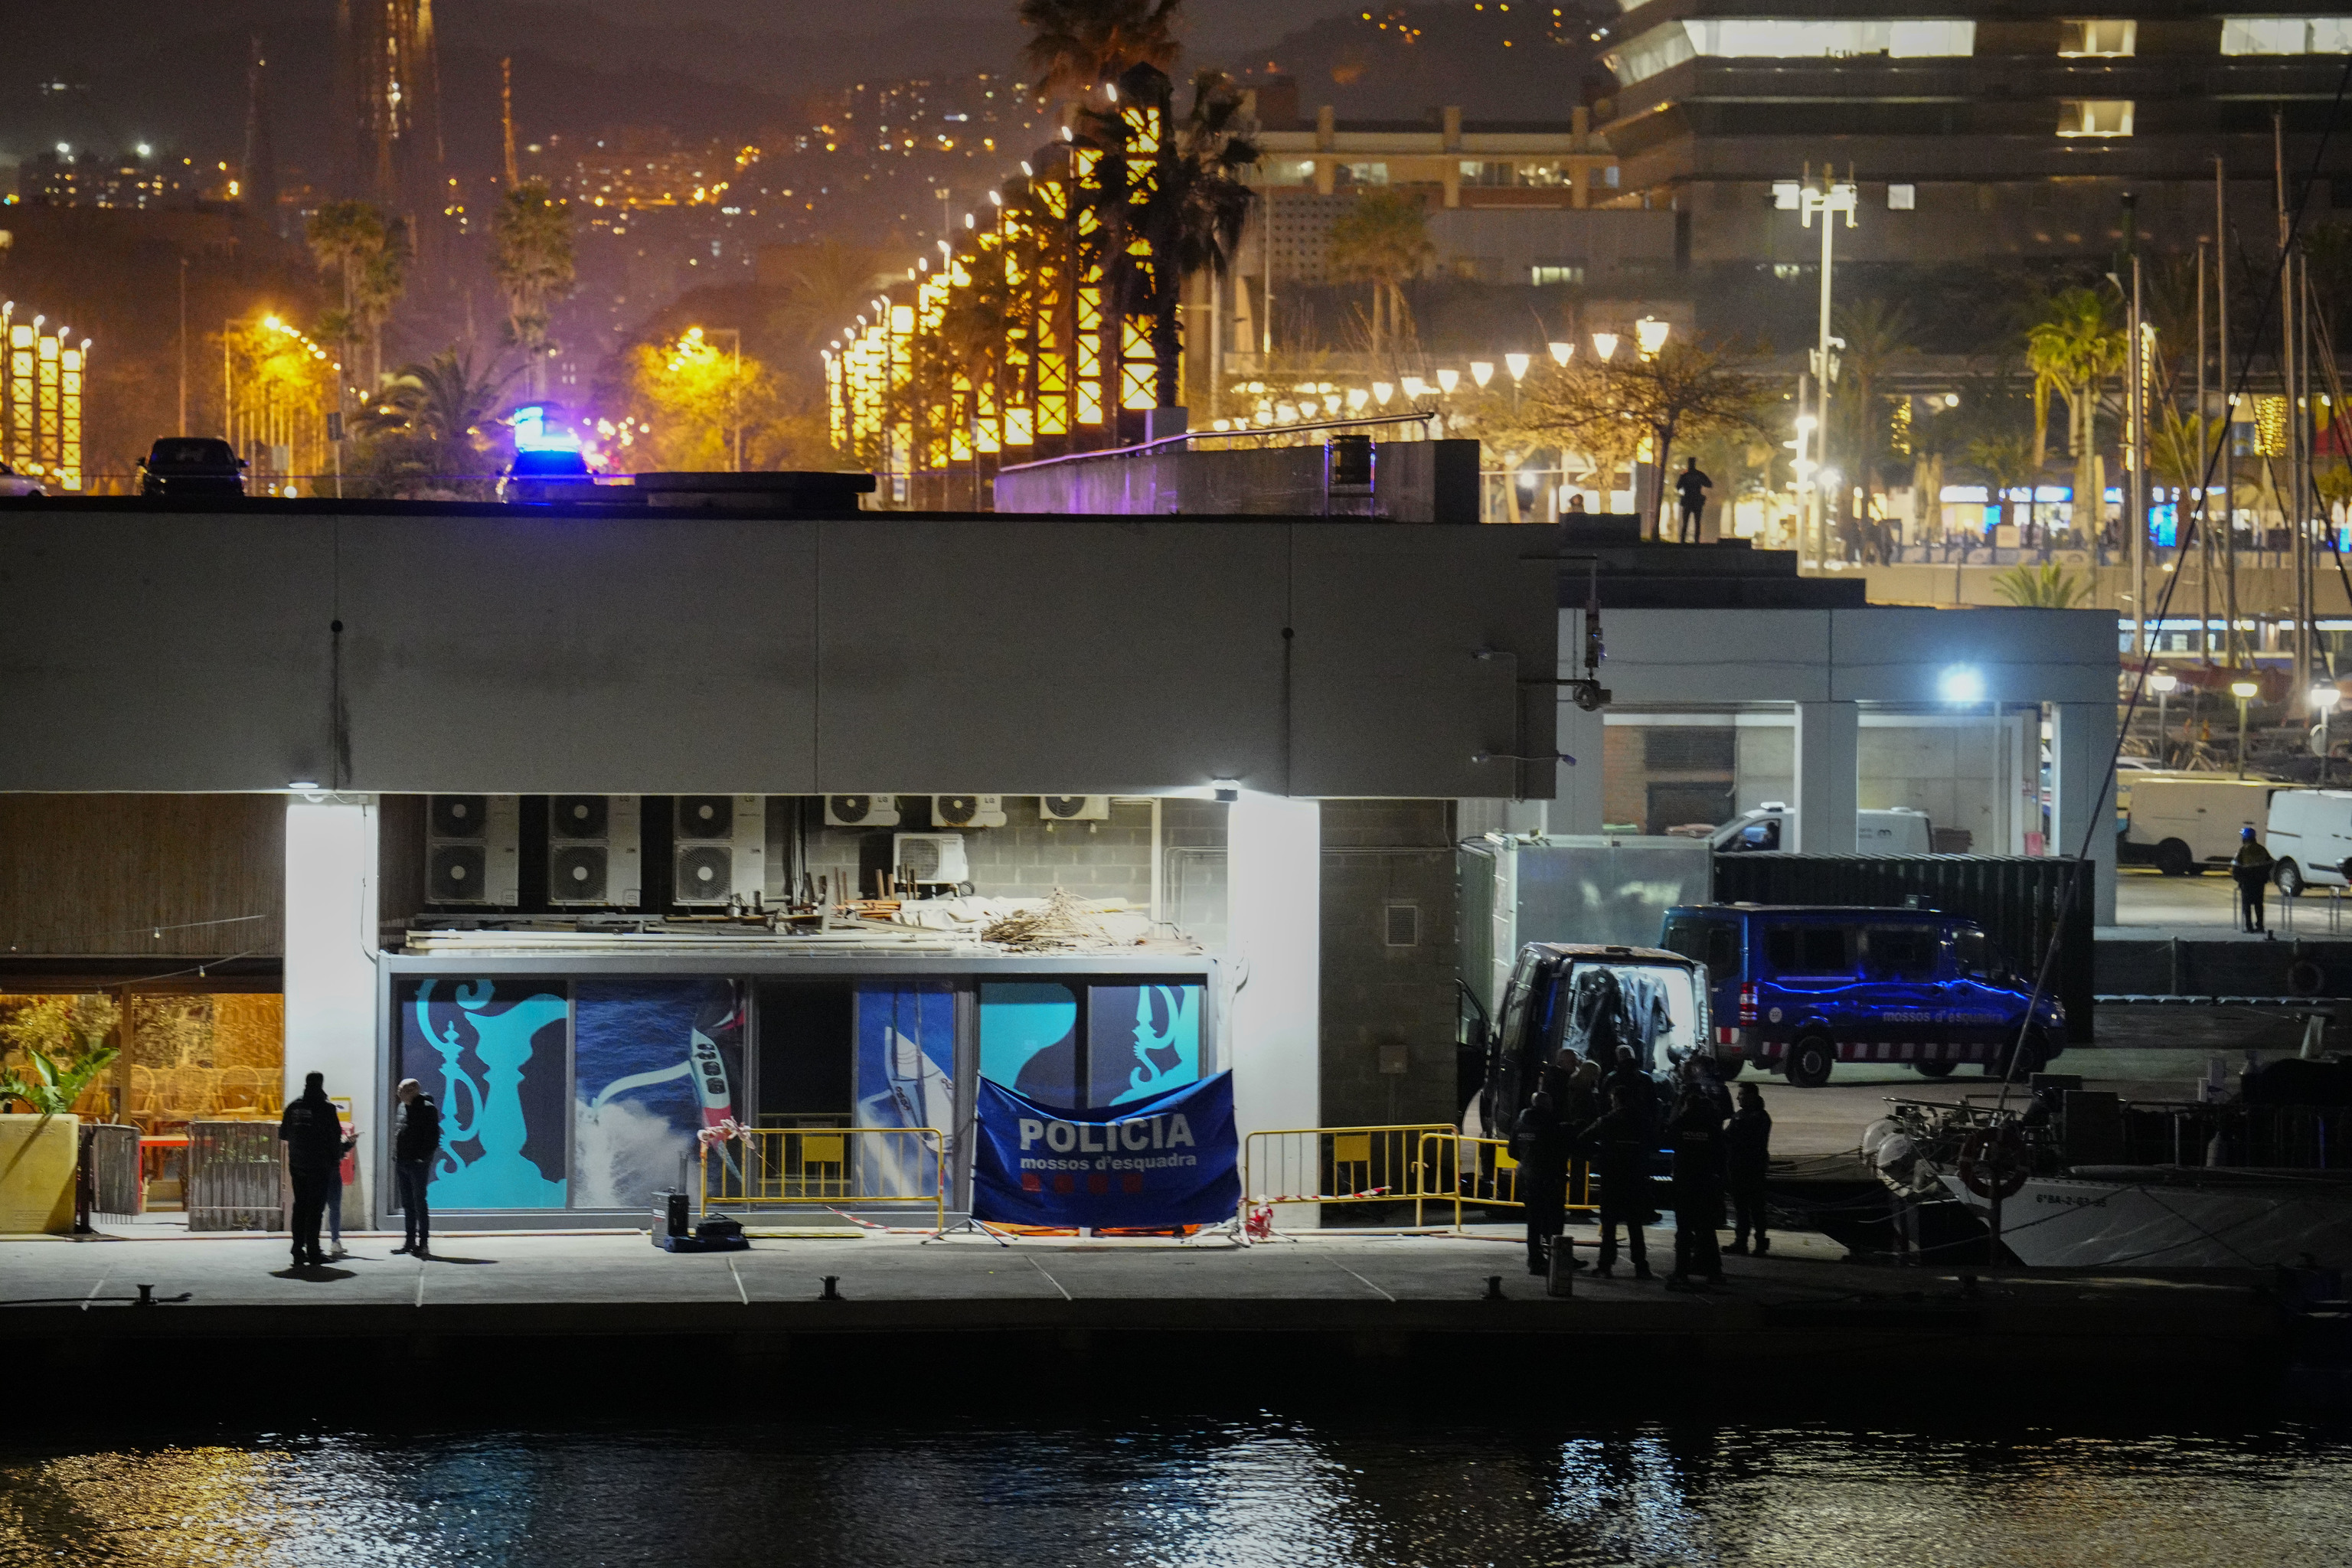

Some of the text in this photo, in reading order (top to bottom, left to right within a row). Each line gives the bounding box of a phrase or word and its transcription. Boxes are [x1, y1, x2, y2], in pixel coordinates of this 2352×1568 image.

[1883, 1011, 1930, 1023] mossos
[1019, 1113, 1195, 1152] POLICIA
[1021, 1152, 1197, 1172] mossos d'esquadra
